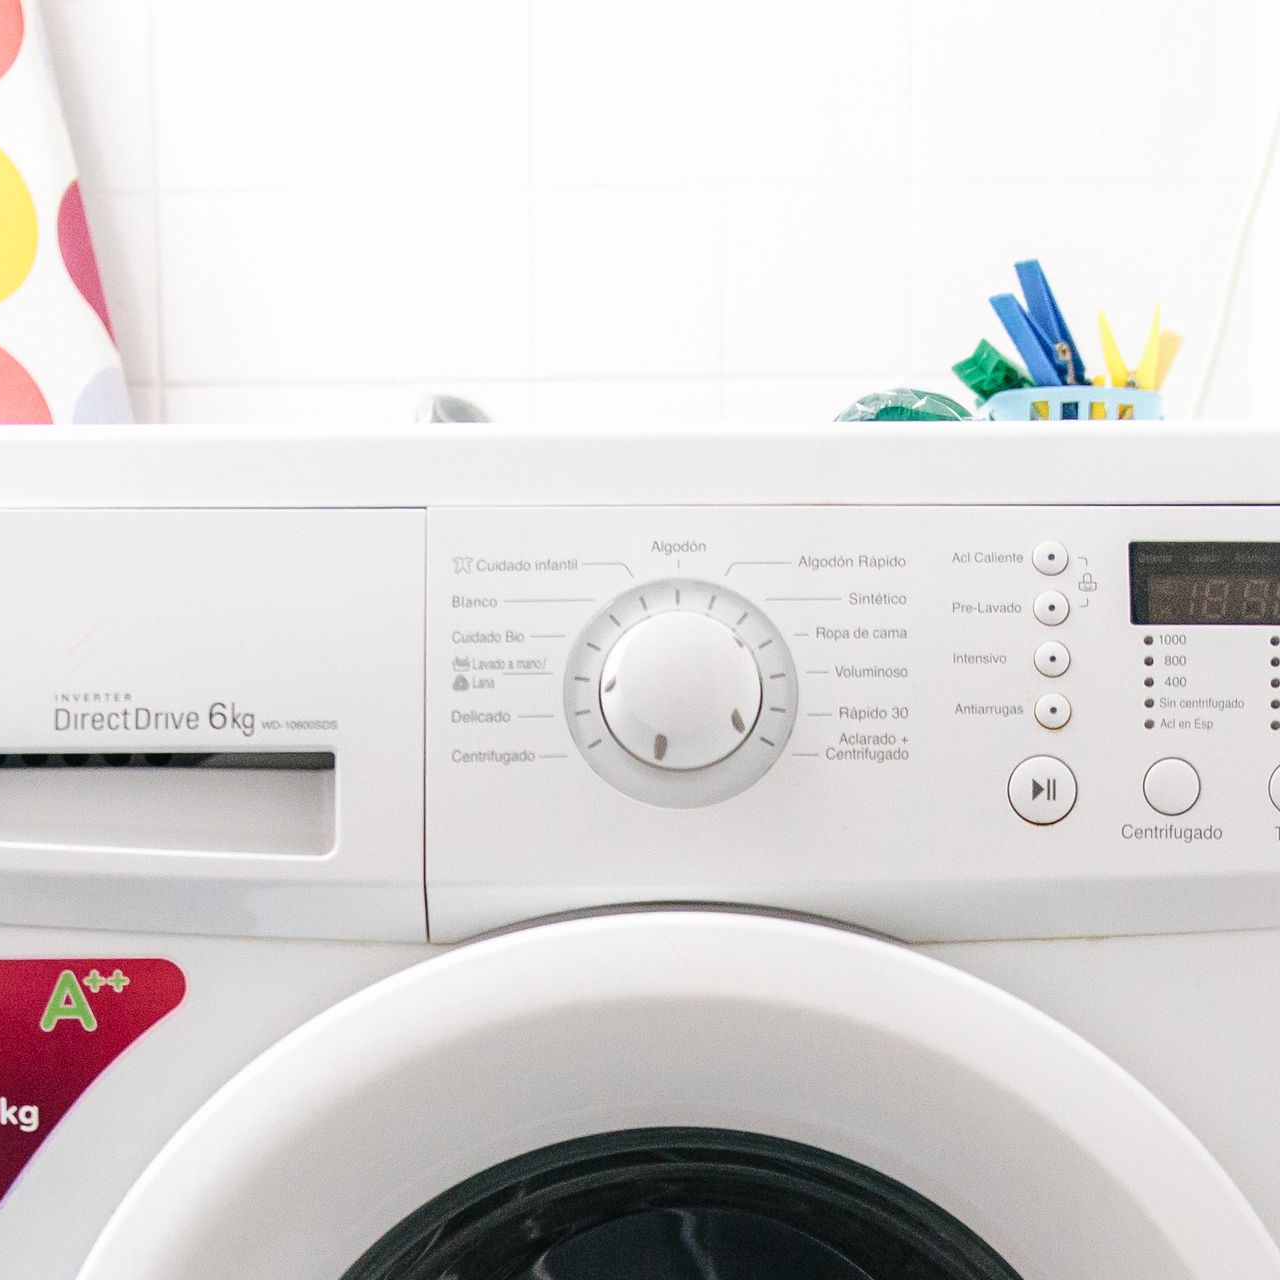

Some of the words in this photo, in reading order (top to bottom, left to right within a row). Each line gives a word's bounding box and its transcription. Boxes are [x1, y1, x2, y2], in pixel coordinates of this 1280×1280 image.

[651, 540, 706, 556] Algodón
[798, 555, 854, 571] Algodón
[858, 555, 907, 570] Rápido
[973, 551, 1024, 563] Caliente
[476, 559, 532, 572] Cuidado
[534, 558, 578, 572] infantil
[451, 595, 498, 608] Blanco
[848, 592, 907, 605] Sintético
[951, 602, 1022, 614] Pre-Lavado
[451, 631, 502, 644] Cuidado
[505, 630, 525, 643] Bio
[816, 627, 850, 643] Ropa
[853, 627, 869, 639] de
[872, 629, 908, 640] cama
[1159, 634, 1187, 645] 1000
[472, 656, 506, 671] Lavado
[507, 660, 514, 670] a
[952, 653, 1007, 665] Intensivo
[1164, 655, 1187, 666] 800
[834, 665, 908, 679] Voluminoso
[472, 677, 495, 689] Lana
[1164, 676, 1187, 687] 400
[54, 692, 132, 702] INVERTER
[1160, 697, 1176, 709] Sin
[1179, 697, 1245, 711] centrifugado
[451, 711, 512, 723] Delicado
[839, 707, 888, 720] Rápido
[891, 707, 909, 719] 30
[954, 704, 1024, 718] Antiarrugas
[1178, 720, 1191, 729] en
[1194, 718, 1214, 731] Esp
[839, 733, 897, 746] Aclarado
[451, 750, 536, 765] Centrifugado
[825, 748, 909, 764] Centrifugado
[1121, 823, 1223, 844] Centrifugado
[40, 969, 130, 1032] A++
[0, 1096, 40, 1132] kg
